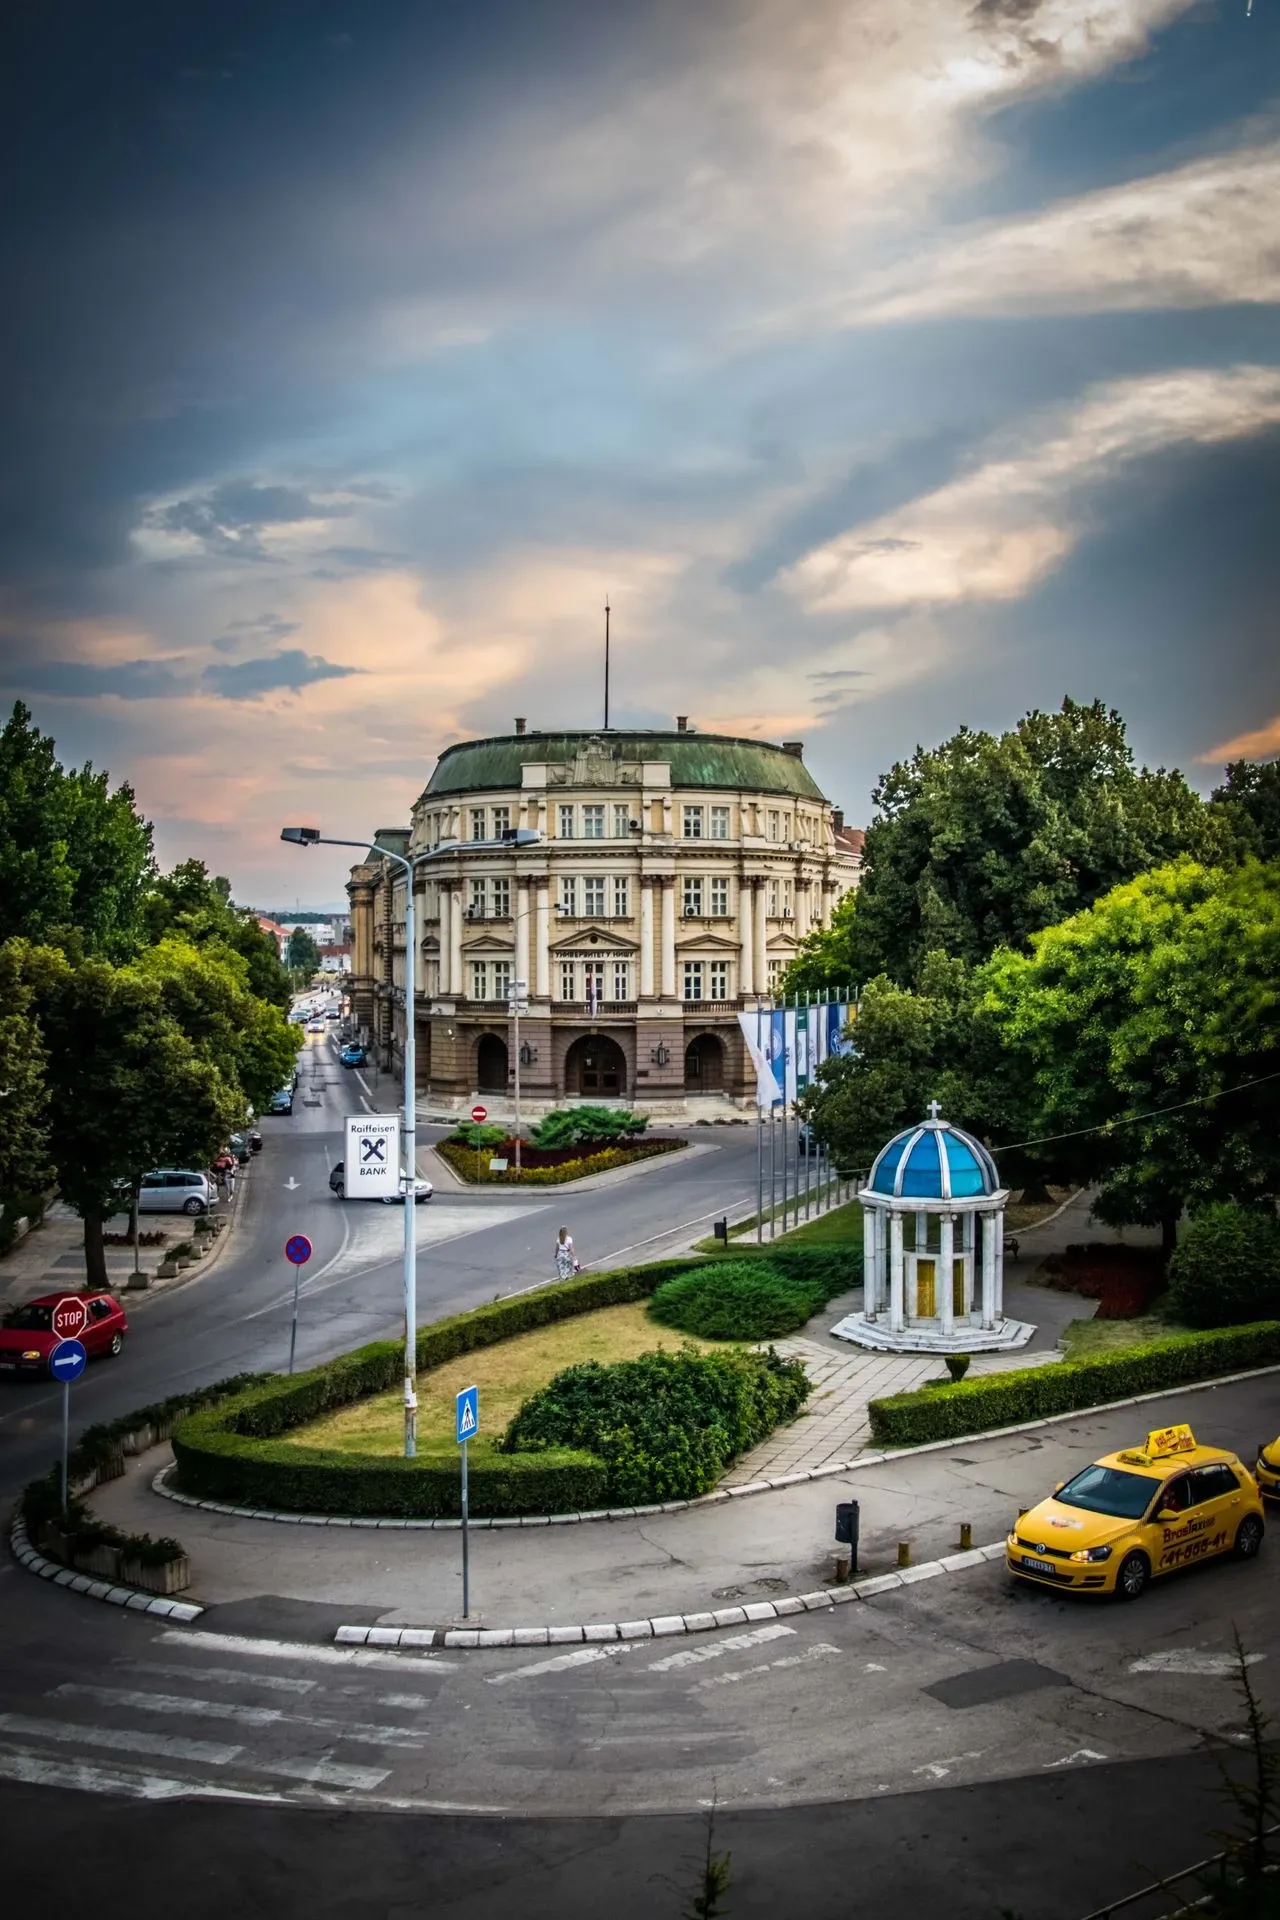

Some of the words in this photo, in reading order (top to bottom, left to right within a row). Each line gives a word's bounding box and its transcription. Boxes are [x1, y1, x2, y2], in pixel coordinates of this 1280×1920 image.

[351, 1124, 395, 1133] Raiffeisen
[360, 1167, 387, 1176] BANK
[57, 1311, 82, 1327] STOP
